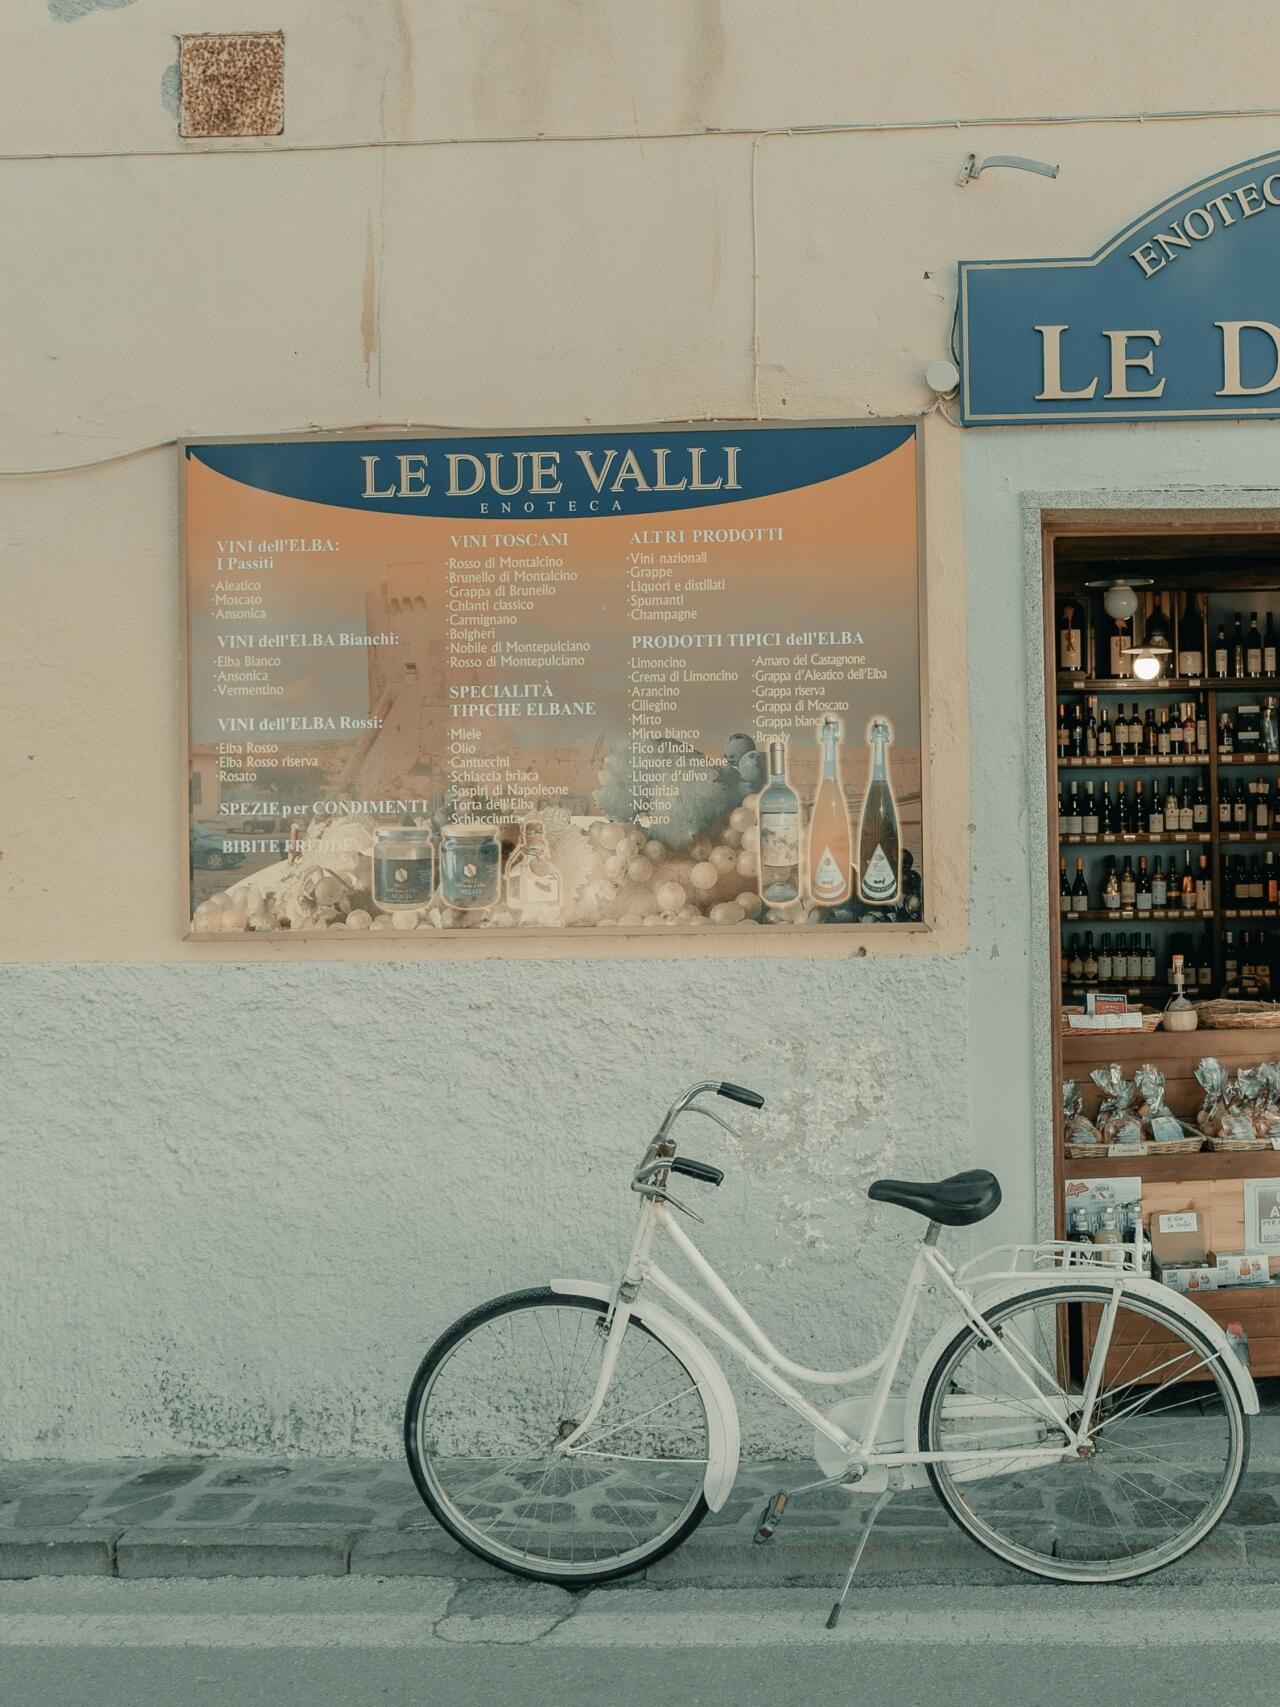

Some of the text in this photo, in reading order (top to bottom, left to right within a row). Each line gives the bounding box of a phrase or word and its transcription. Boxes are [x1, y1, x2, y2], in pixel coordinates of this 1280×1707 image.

[1034, 323, 1167, 401] LE
[360, 446, 742, 498] LE DUE VALLI
[450, 533, 569, 548] VINI TOSCANI
[630, 527, 784, 544] ALTRI PRODOTTI
[217, 539, 340, 553] VINI dell'ELBA:
[216, 557, 274, 571] I Passiti
[449, 556, 563, 570] Rosso di Montalcino
[630, 552, 707, 565] Vini nazionali
[449, 569, 578, 583] Brunello di Montalcino
[630, 566, 672, 580] Grappe
[216, 580, 261, 591] Aleatico
[449, 584, 556, 599] Grappa di Brunello
[630, 579, 725, 594] Liquori e distillati
[216, 594, 262, 605] Moscato
[449, 598, 534, 611] Chianti classico
[630, 594, 684, 608] Spumanti
[216, 608, 266, 619] Ansonica
[449, 613, 517, 627] Carmignano
[630, 608, 697, 623] Champagne
[217, 633, 400, 648] VINI dell'ELBA Bianchi:
[449, 627, 496, 642] Bolgheri
[632, 631, 864, 649] PRODOTTI TIPICI dell'ELBA
[449, 639, 591, 655] Nobile di Montepulciano
[217, 655, 281, 667] Elba Bianco
[449, 654, 585, 669] Rosso di Montepulciano
[631, 657, 686, 669] Limoncino
[755, 653, 866, 668] Amaro del Castagnone
[217, 670, 268, 681] Ansonica
[631, 670, 738, 683] Crema di Limoncino
[755, 669, 791, 684] Grappa
[217, 684, 284, 696] Vermentino
[450, 681, 553, 698] SPECIALITÀ
[632, 686, 680, 697] Arancino
[756, 684, 825, 699] Grappa riserva
[451, 702, 596, 717] TIPICHE ELBANE
[632, 700, 677, 714] Ciliegino
[756, 699, 849, 715] Grappa di Moscato
[218, 716, 384, 731] VINI dell'ELBA Rossi:
[632, 714, 661, 725] Mirto
[756, 716, 792, 730] Grappa
[451, 728, 482, 740] Miele
[632, 728, 699, 740] Mirto bianco
[756, 731, 790, 744] Brandy
[219, 742, 278, 754] Elba Rosso
[451, 743, 476, 754] Olio
[632, 742, 695, 754] Fico d'India
[219, 756, 318, 768] Elba Rosso riserva
[451, 757, 510, 768] Cantuccini
[633, 756, 728, 770] Liquore di melone
[219, 771, 256, 783] Rosato
[451, 769, 539, 782] Schiaccia briaca
[633, 771, 667, 784] Liquor
[451, 784, 568, 798] Sospiri di Napoleone
[633, 785, 679, 798] Liquirizia
[219, 799, 428, 818] SPEZIE per CONDIMENTI
[451, 798, 534, 811] Torta dell'Elba
[633, 799, 672, 811] Nocino
[451, 812, 520, 825] Schiacciunta
[222, 840, 280, 854] BIBITE
